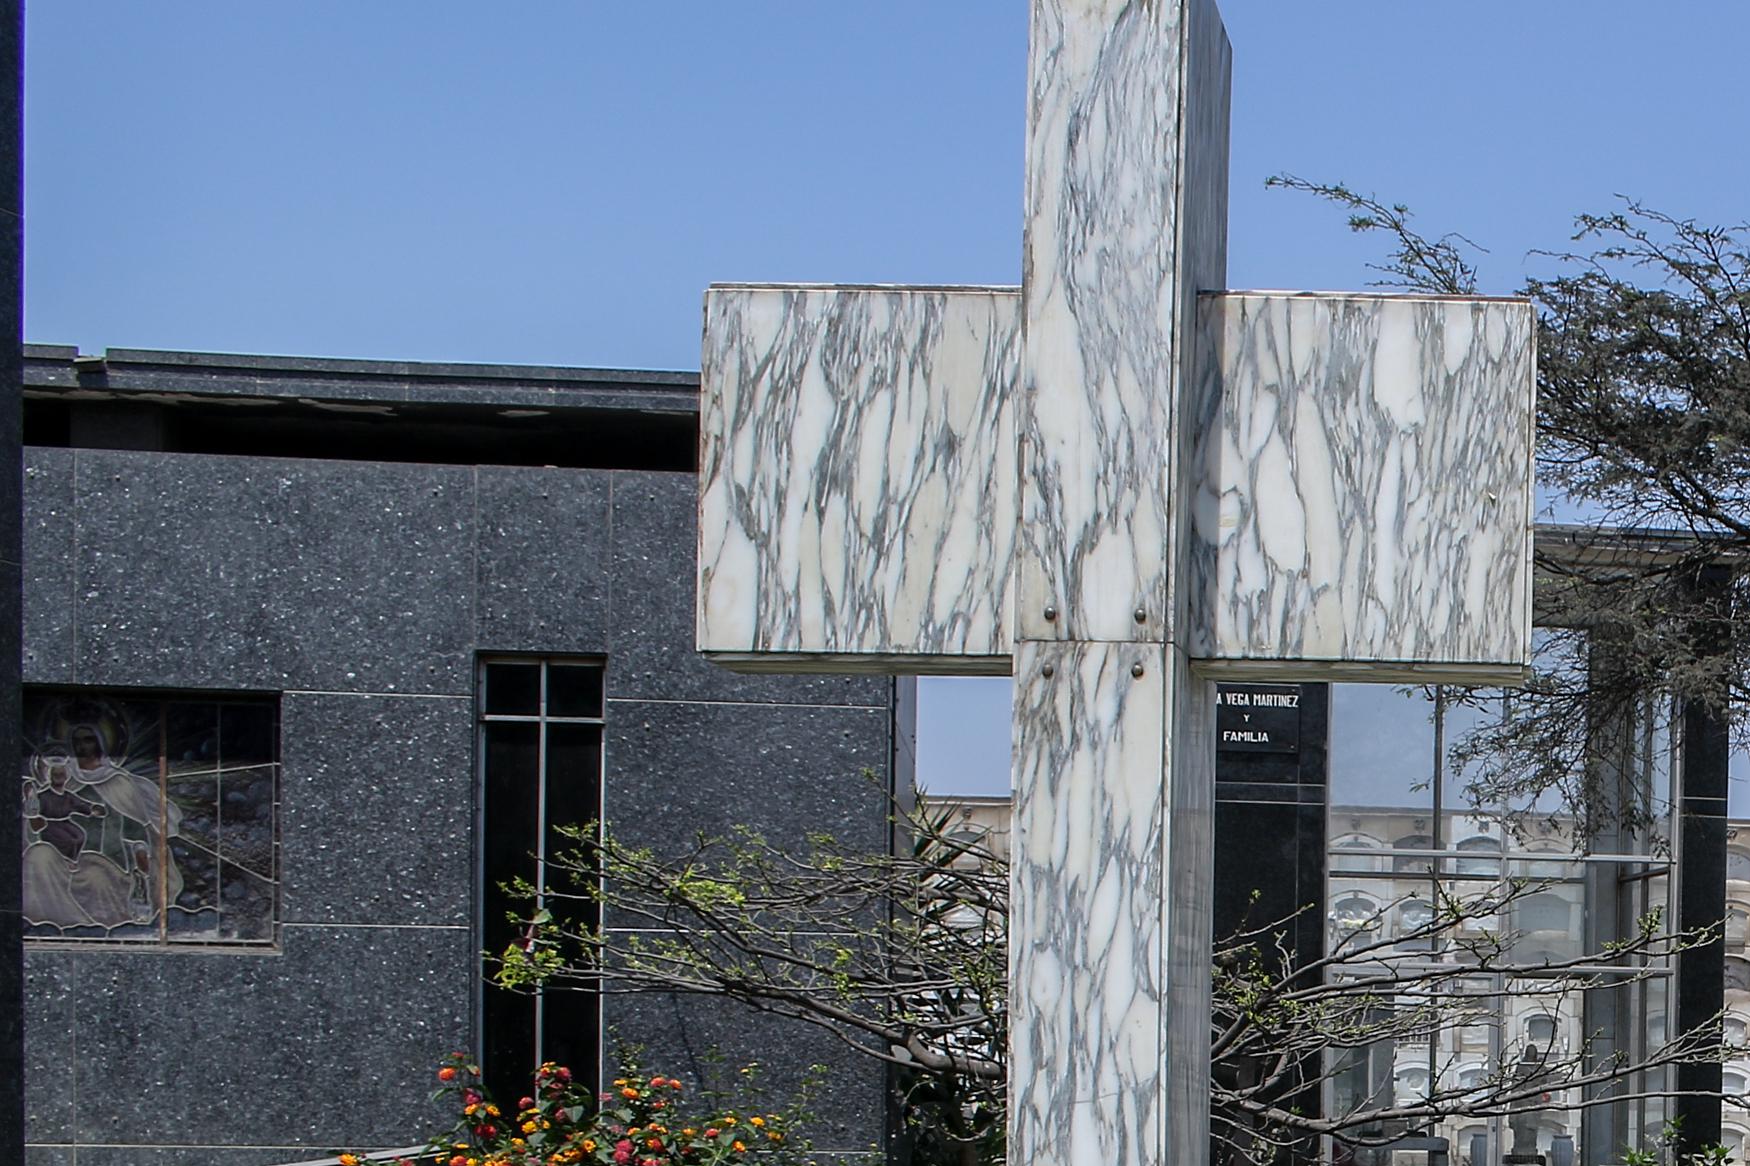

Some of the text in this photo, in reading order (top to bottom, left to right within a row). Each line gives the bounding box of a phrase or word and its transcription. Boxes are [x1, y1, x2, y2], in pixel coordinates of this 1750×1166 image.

[1226, 693, 1250, 706] VEGA
[1253, 694, 1299, 708] MARTINEZ
[1243, 714, 1250, 722] Y
[1223, 731, 1269, 742] FAMILIA
